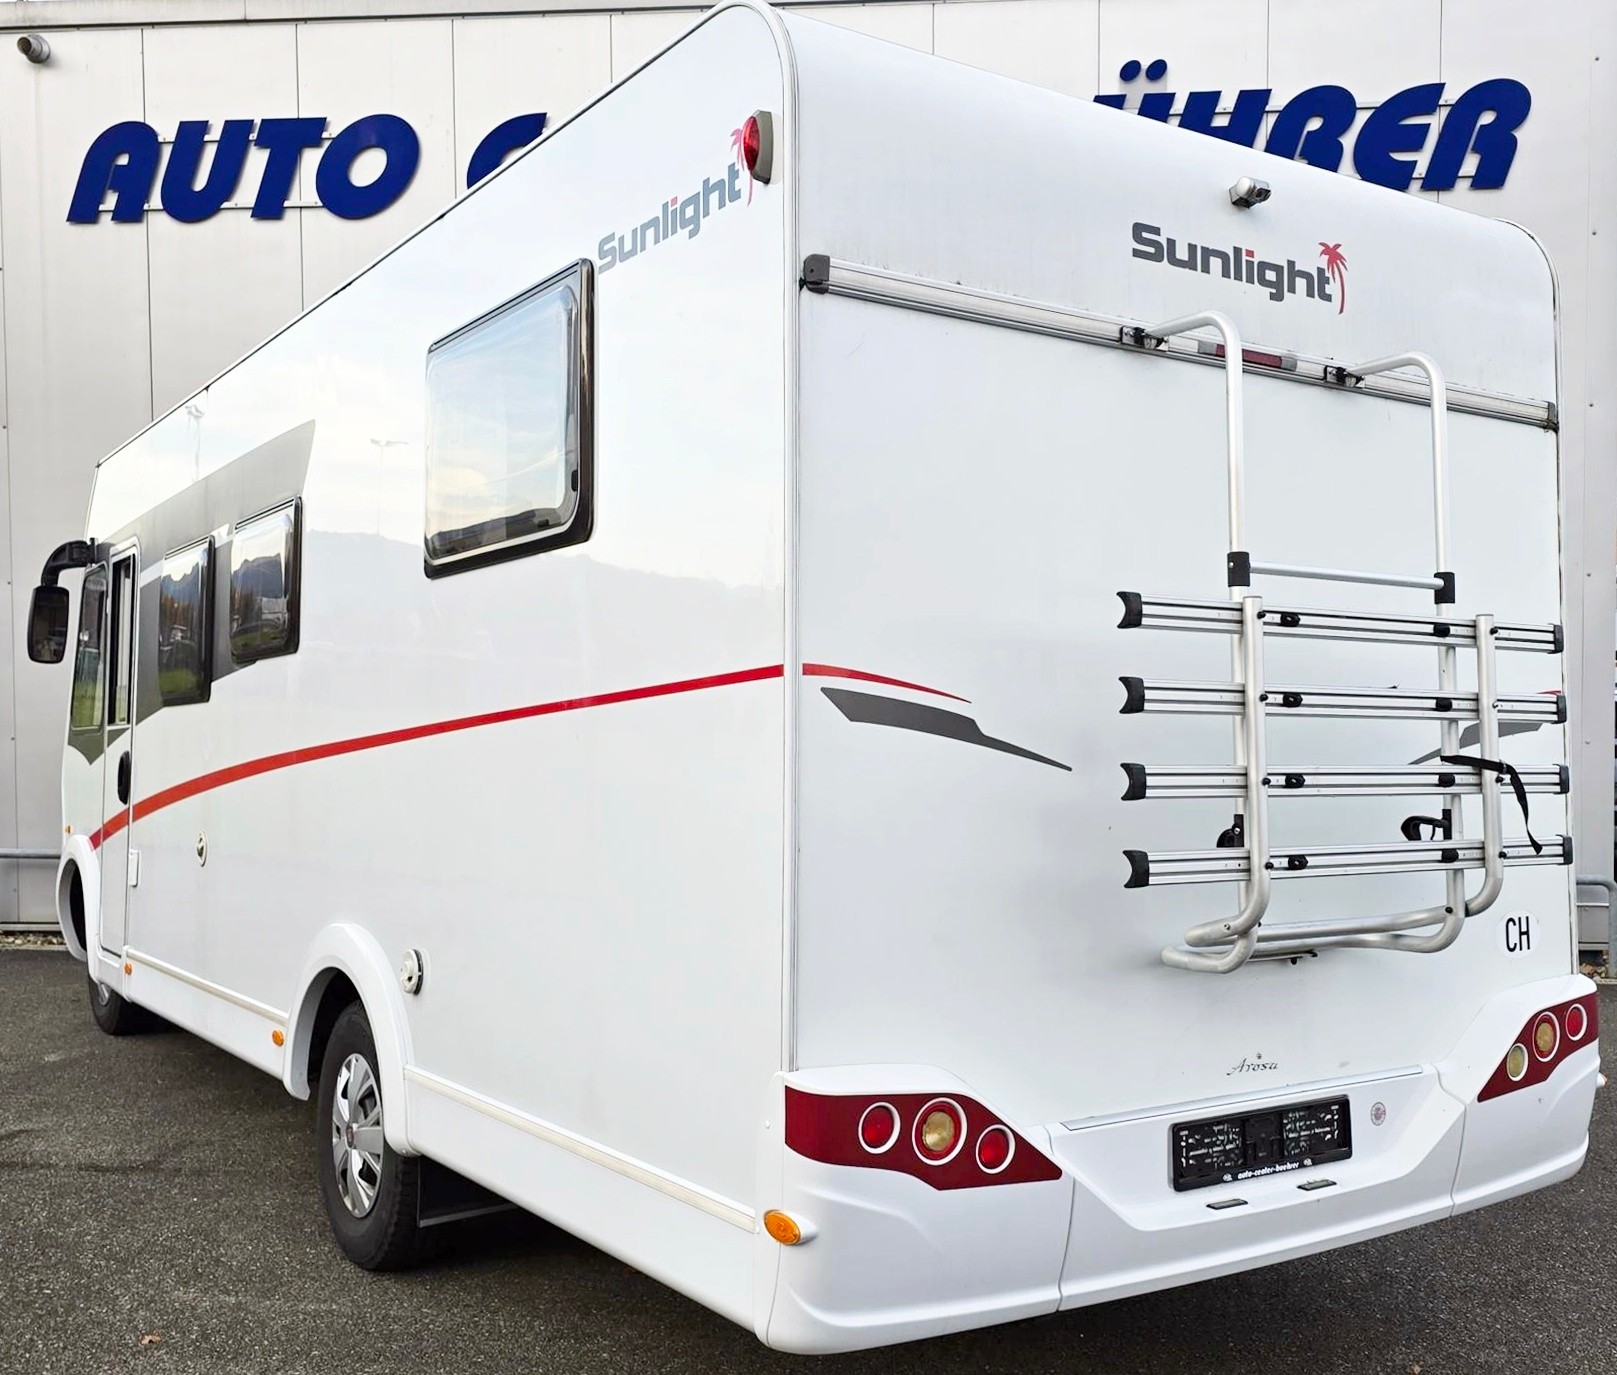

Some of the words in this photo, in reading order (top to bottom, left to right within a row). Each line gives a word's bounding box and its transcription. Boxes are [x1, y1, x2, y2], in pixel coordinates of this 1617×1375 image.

[66, 114, 420, 223] AUTO
[598, 162, 742, 275] Sunlight
[1132, 222, 1333, 302] Sunlight
[1505, 916, 1531, 952] CH
[1227, 1057, 1279, 1076] Arosa
